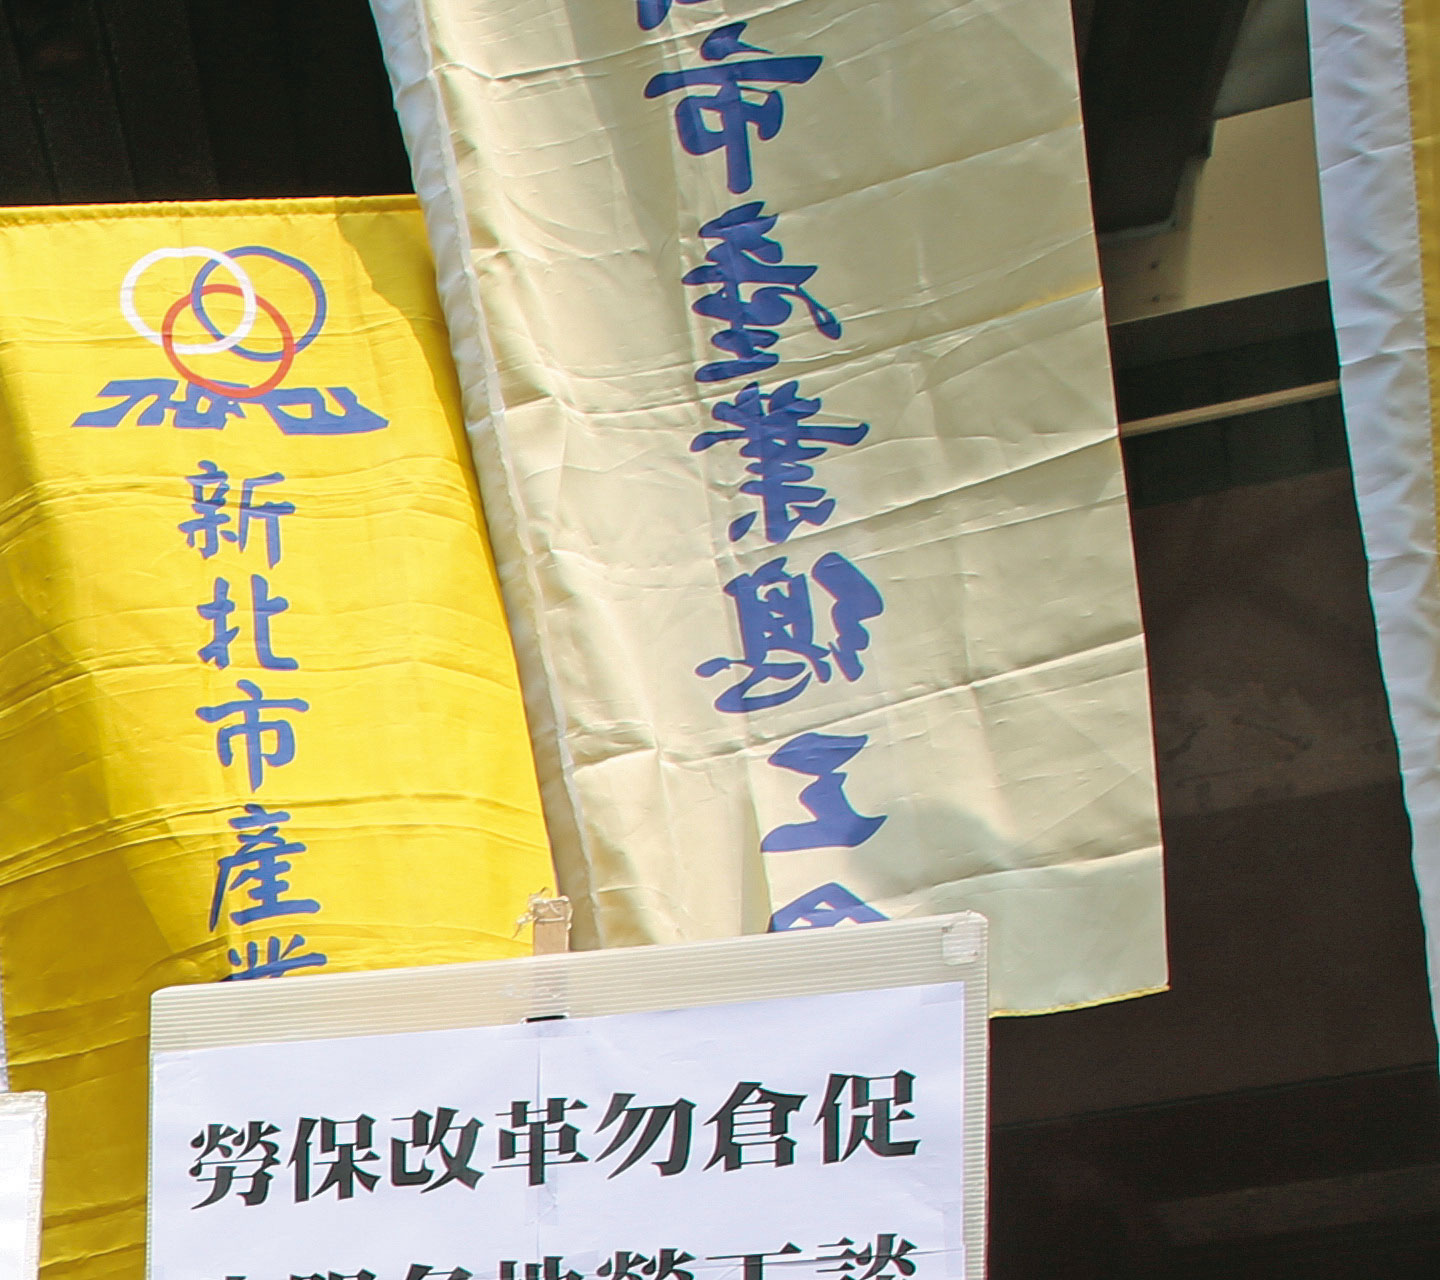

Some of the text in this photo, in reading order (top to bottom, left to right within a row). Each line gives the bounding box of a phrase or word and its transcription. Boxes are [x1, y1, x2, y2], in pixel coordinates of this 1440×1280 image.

[188, 1069, 922, 1211] 勞保改革勿倉促
